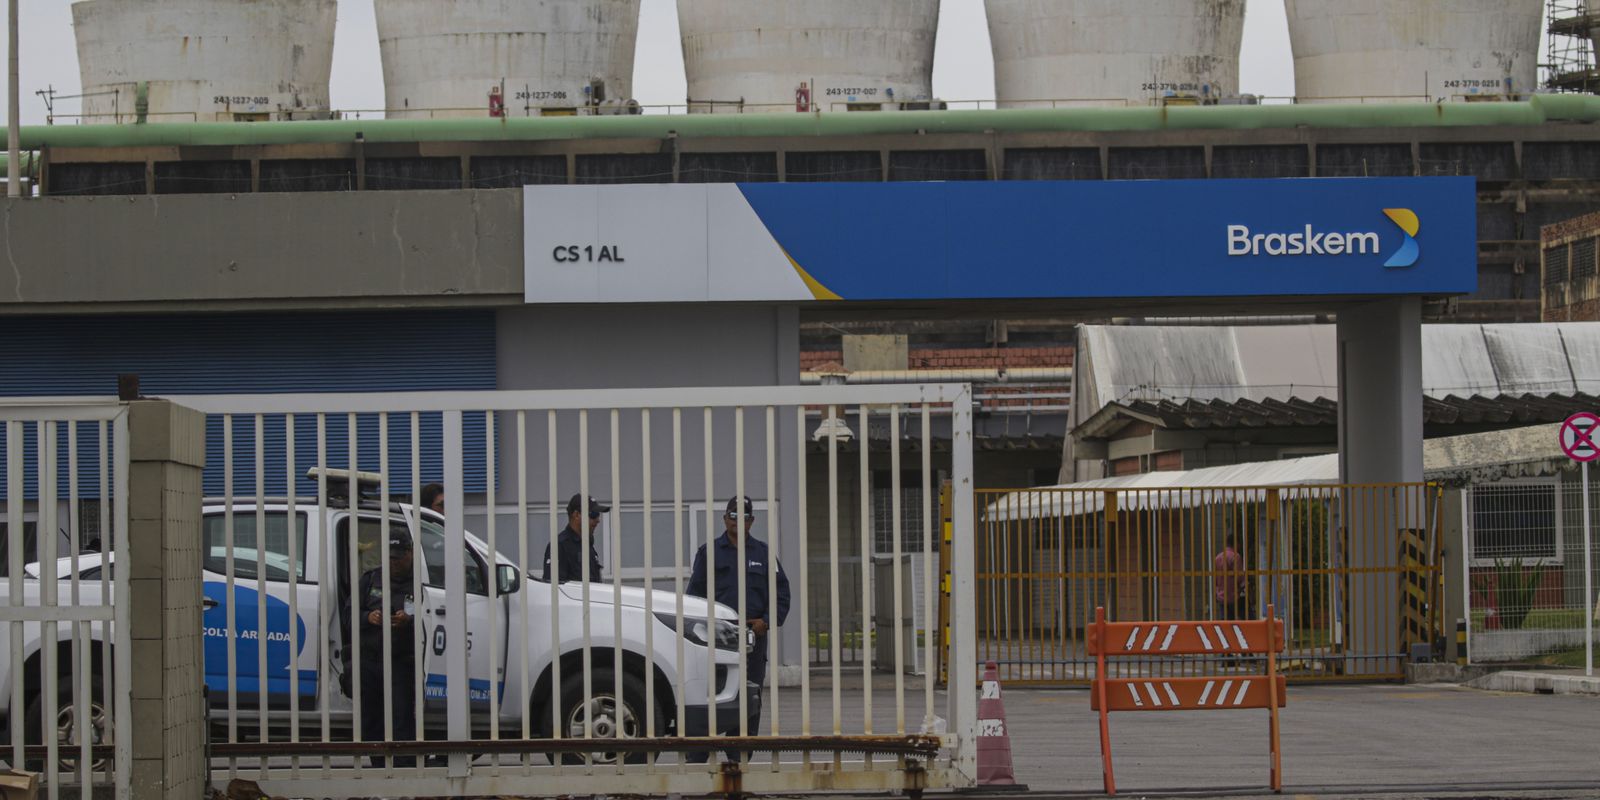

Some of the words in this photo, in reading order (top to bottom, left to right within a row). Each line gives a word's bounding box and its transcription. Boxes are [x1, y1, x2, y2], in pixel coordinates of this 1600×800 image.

[1227, 224, 1380, 256] Braskem
[553, 245, 580, 262] CS
[584, 245, 593, 262] 1
[598, 245, 624, 262] AL
[241, 630, 291, 642] ARADA
